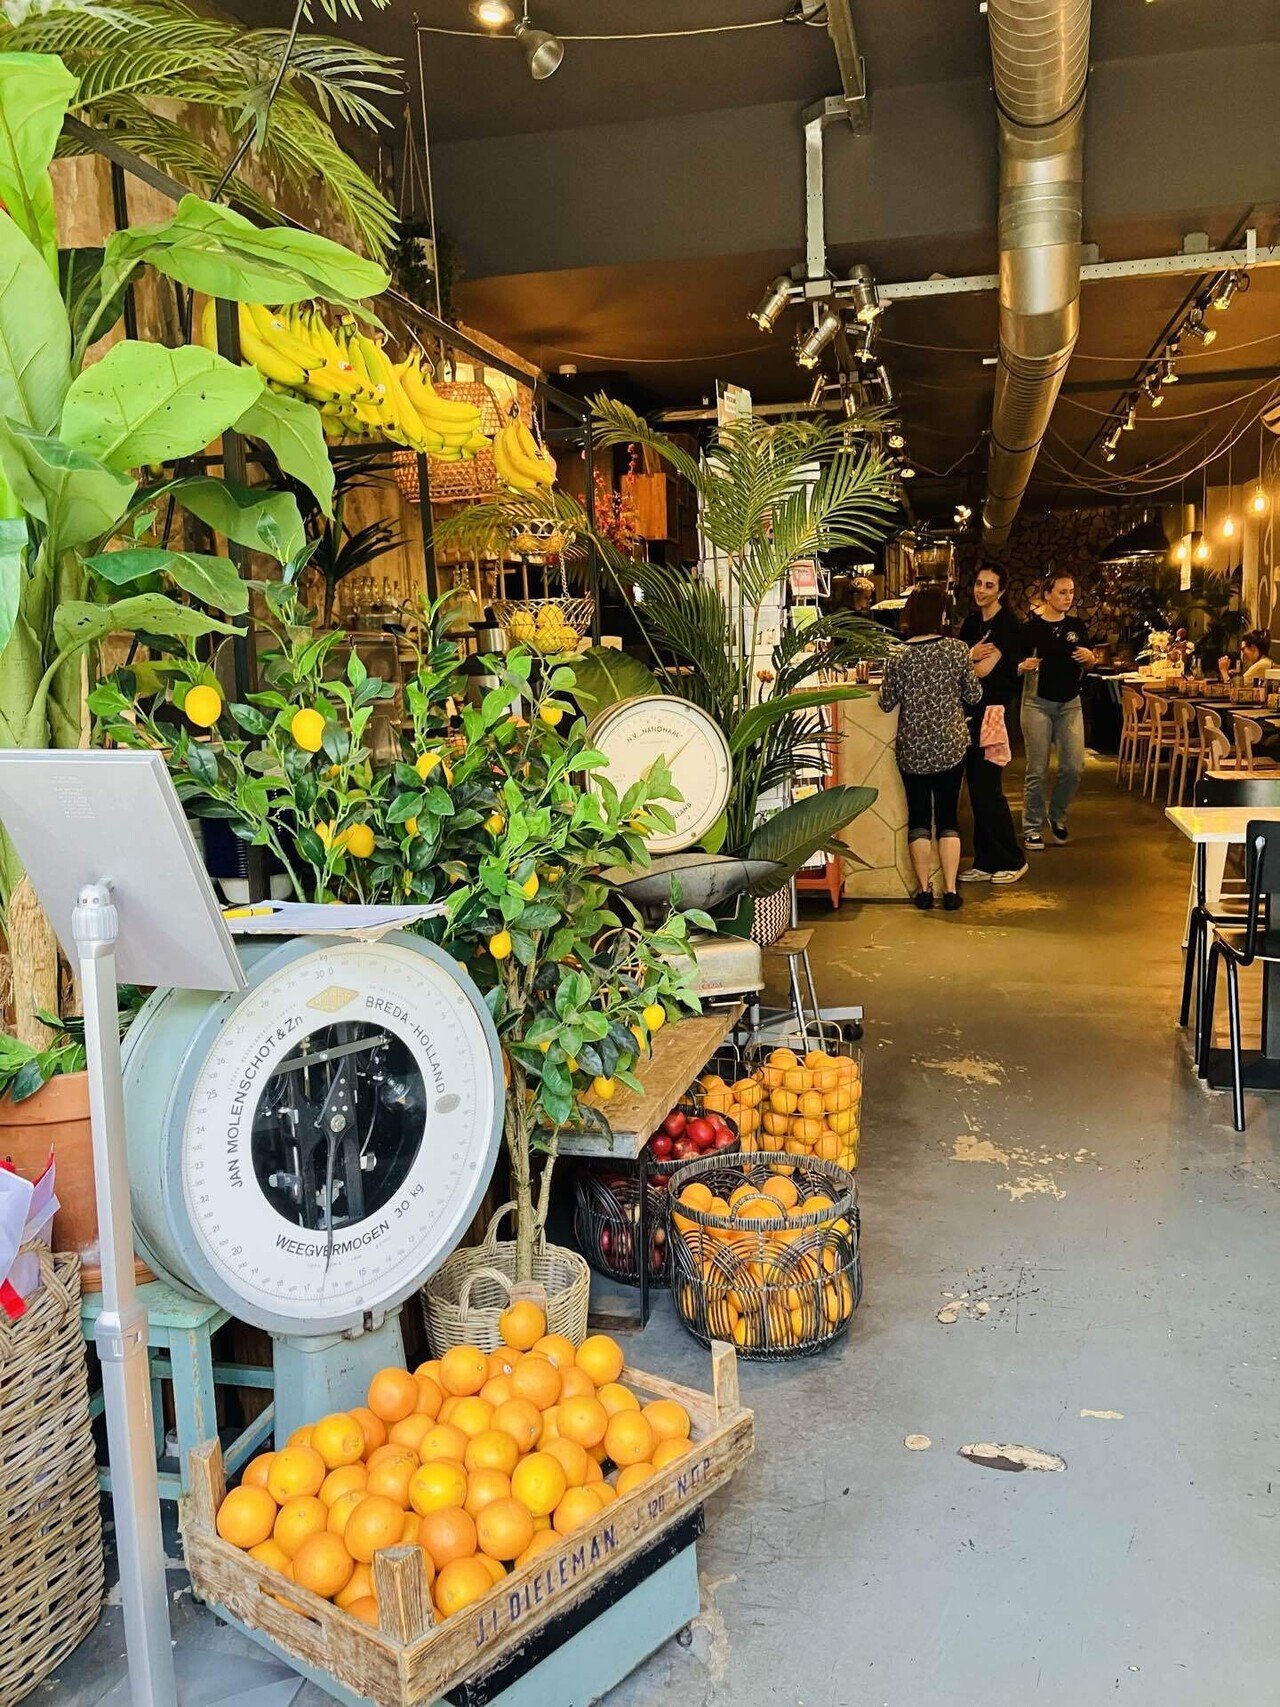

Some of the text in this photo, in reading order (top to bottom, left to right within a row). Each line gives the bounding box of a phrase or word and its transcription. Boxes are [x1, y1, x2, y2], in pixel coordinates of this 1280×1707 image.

[285, 1016, 303, 1033] Zn
[277, 1029, 286, 1041] &
[206, 1089, 218, 1100] 25
[227, 1036, 276, 1155] MOLENSCHOT
[227, 1159, 243, 1188] JAN
[200, 1195, 209, 1203] 22
[275, 1220, 390, 1258] WEEGVERMOGEN
[394, 1200, 410, 1218] 30
[411, 1183, 425, 1199] kg
[231, 1246, 243, 1256] 20
